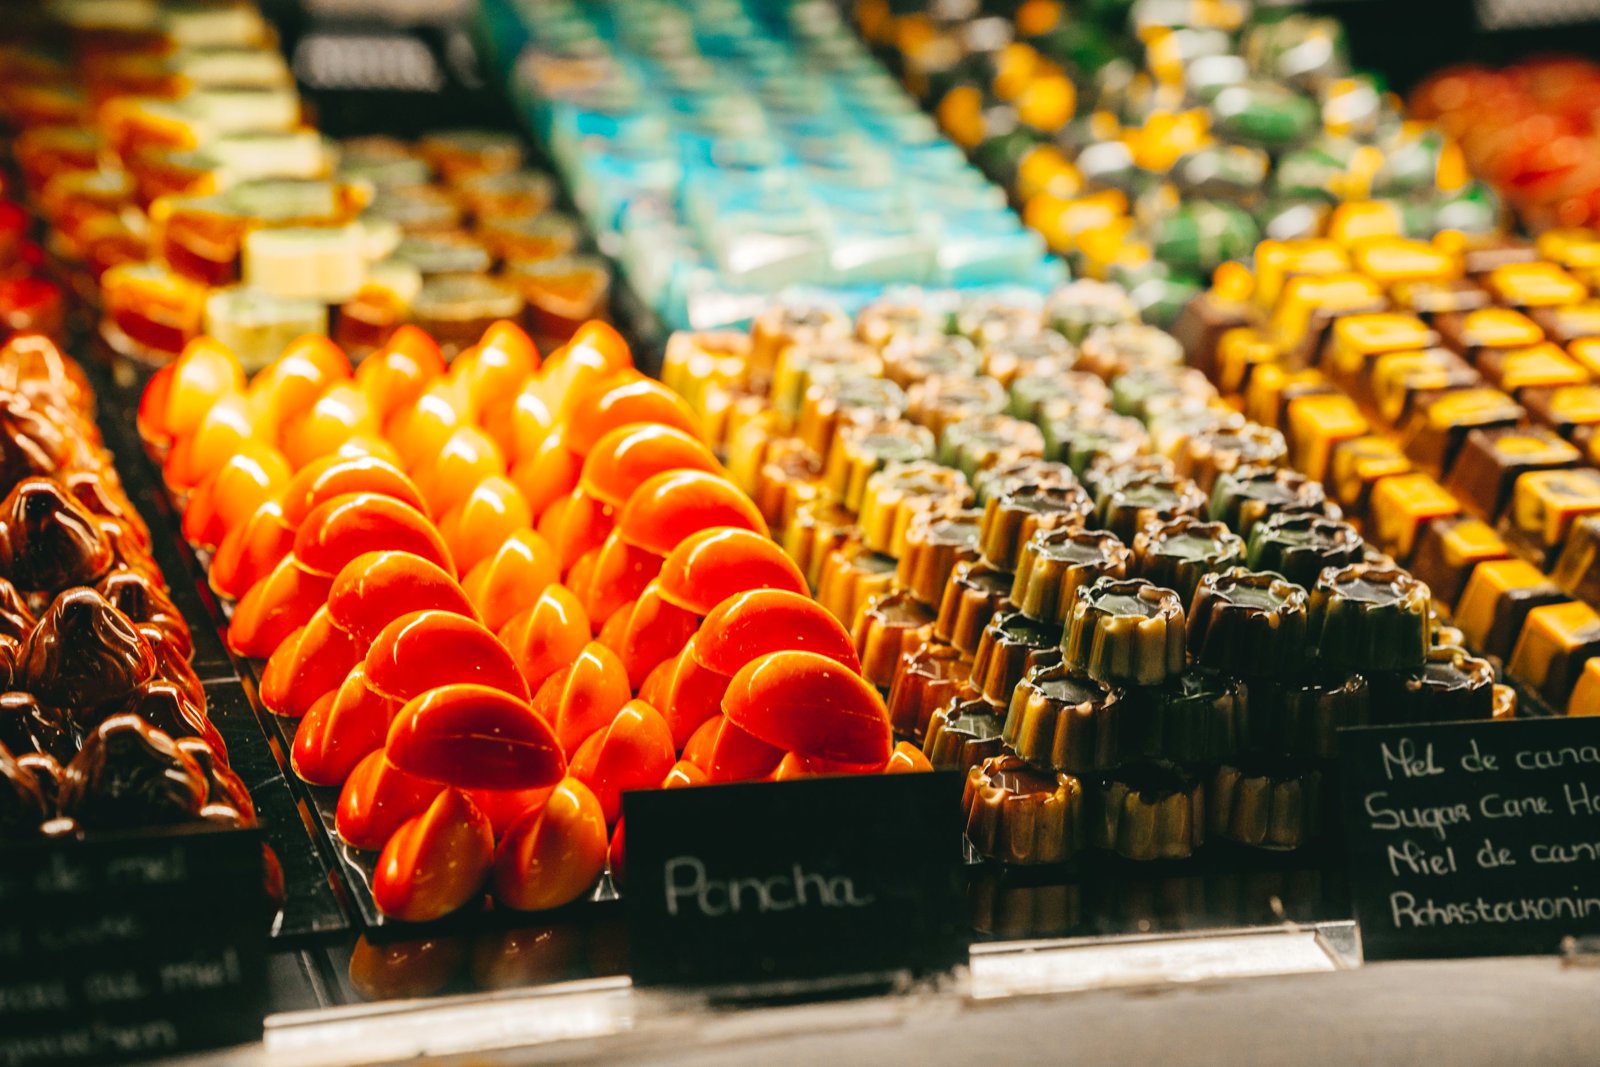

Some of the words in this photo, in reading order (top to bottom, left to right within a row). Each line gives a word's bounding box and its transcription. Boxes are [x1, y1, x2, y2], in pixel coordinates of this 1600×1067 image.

[1460, 738, 1500, 772] de
[1515, 745, 1600, 770] cana
[1364, 791, 1472, 841] Sugar
[1479, 793, 1553, 819] Cane
[1386, 840, 1457, 877] Miel
[1476, 838, 1517, 869] de
[1530, 842, 1600, 864] can
[663, 855, 876, 917] Poncha
